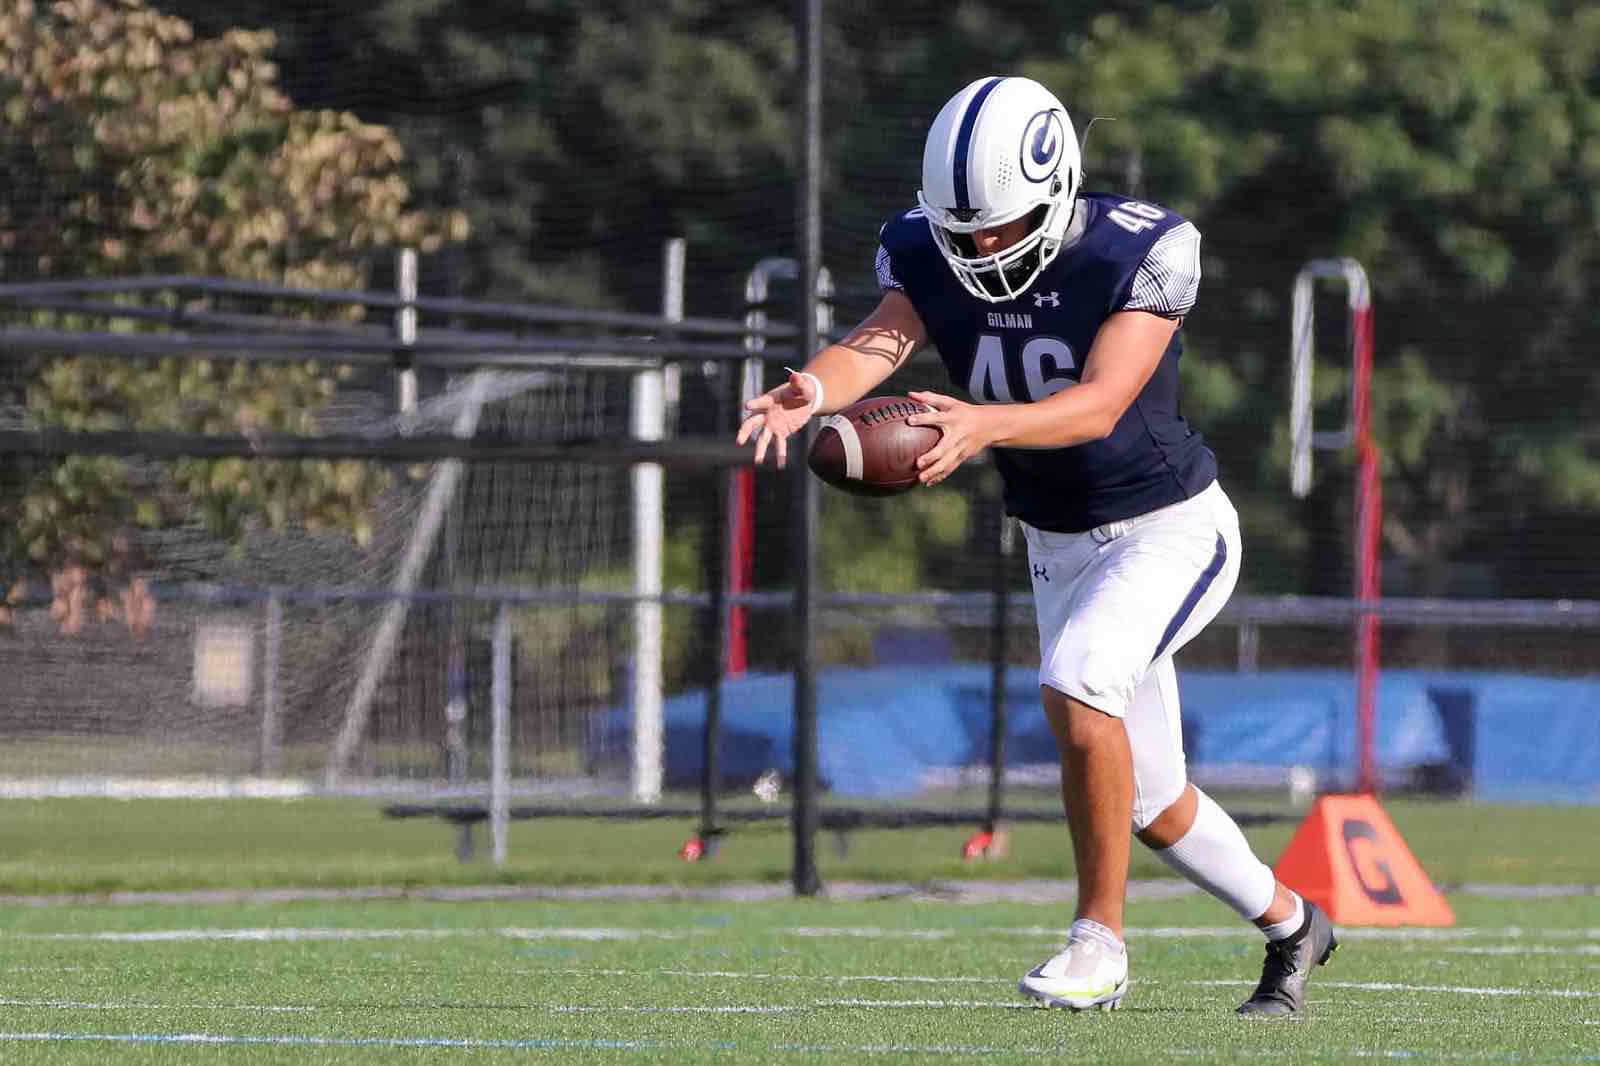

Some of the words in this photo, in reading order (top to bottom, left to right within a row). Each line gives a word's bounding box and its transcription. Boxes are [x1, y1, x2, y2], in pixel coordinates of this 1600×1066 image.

[1106, 201, 1167, 234] 46
[987, 312, 1032, 329] GILMAN
[968, 335, 1080, 404] 46
[1342, 819, 1404, 905] G
